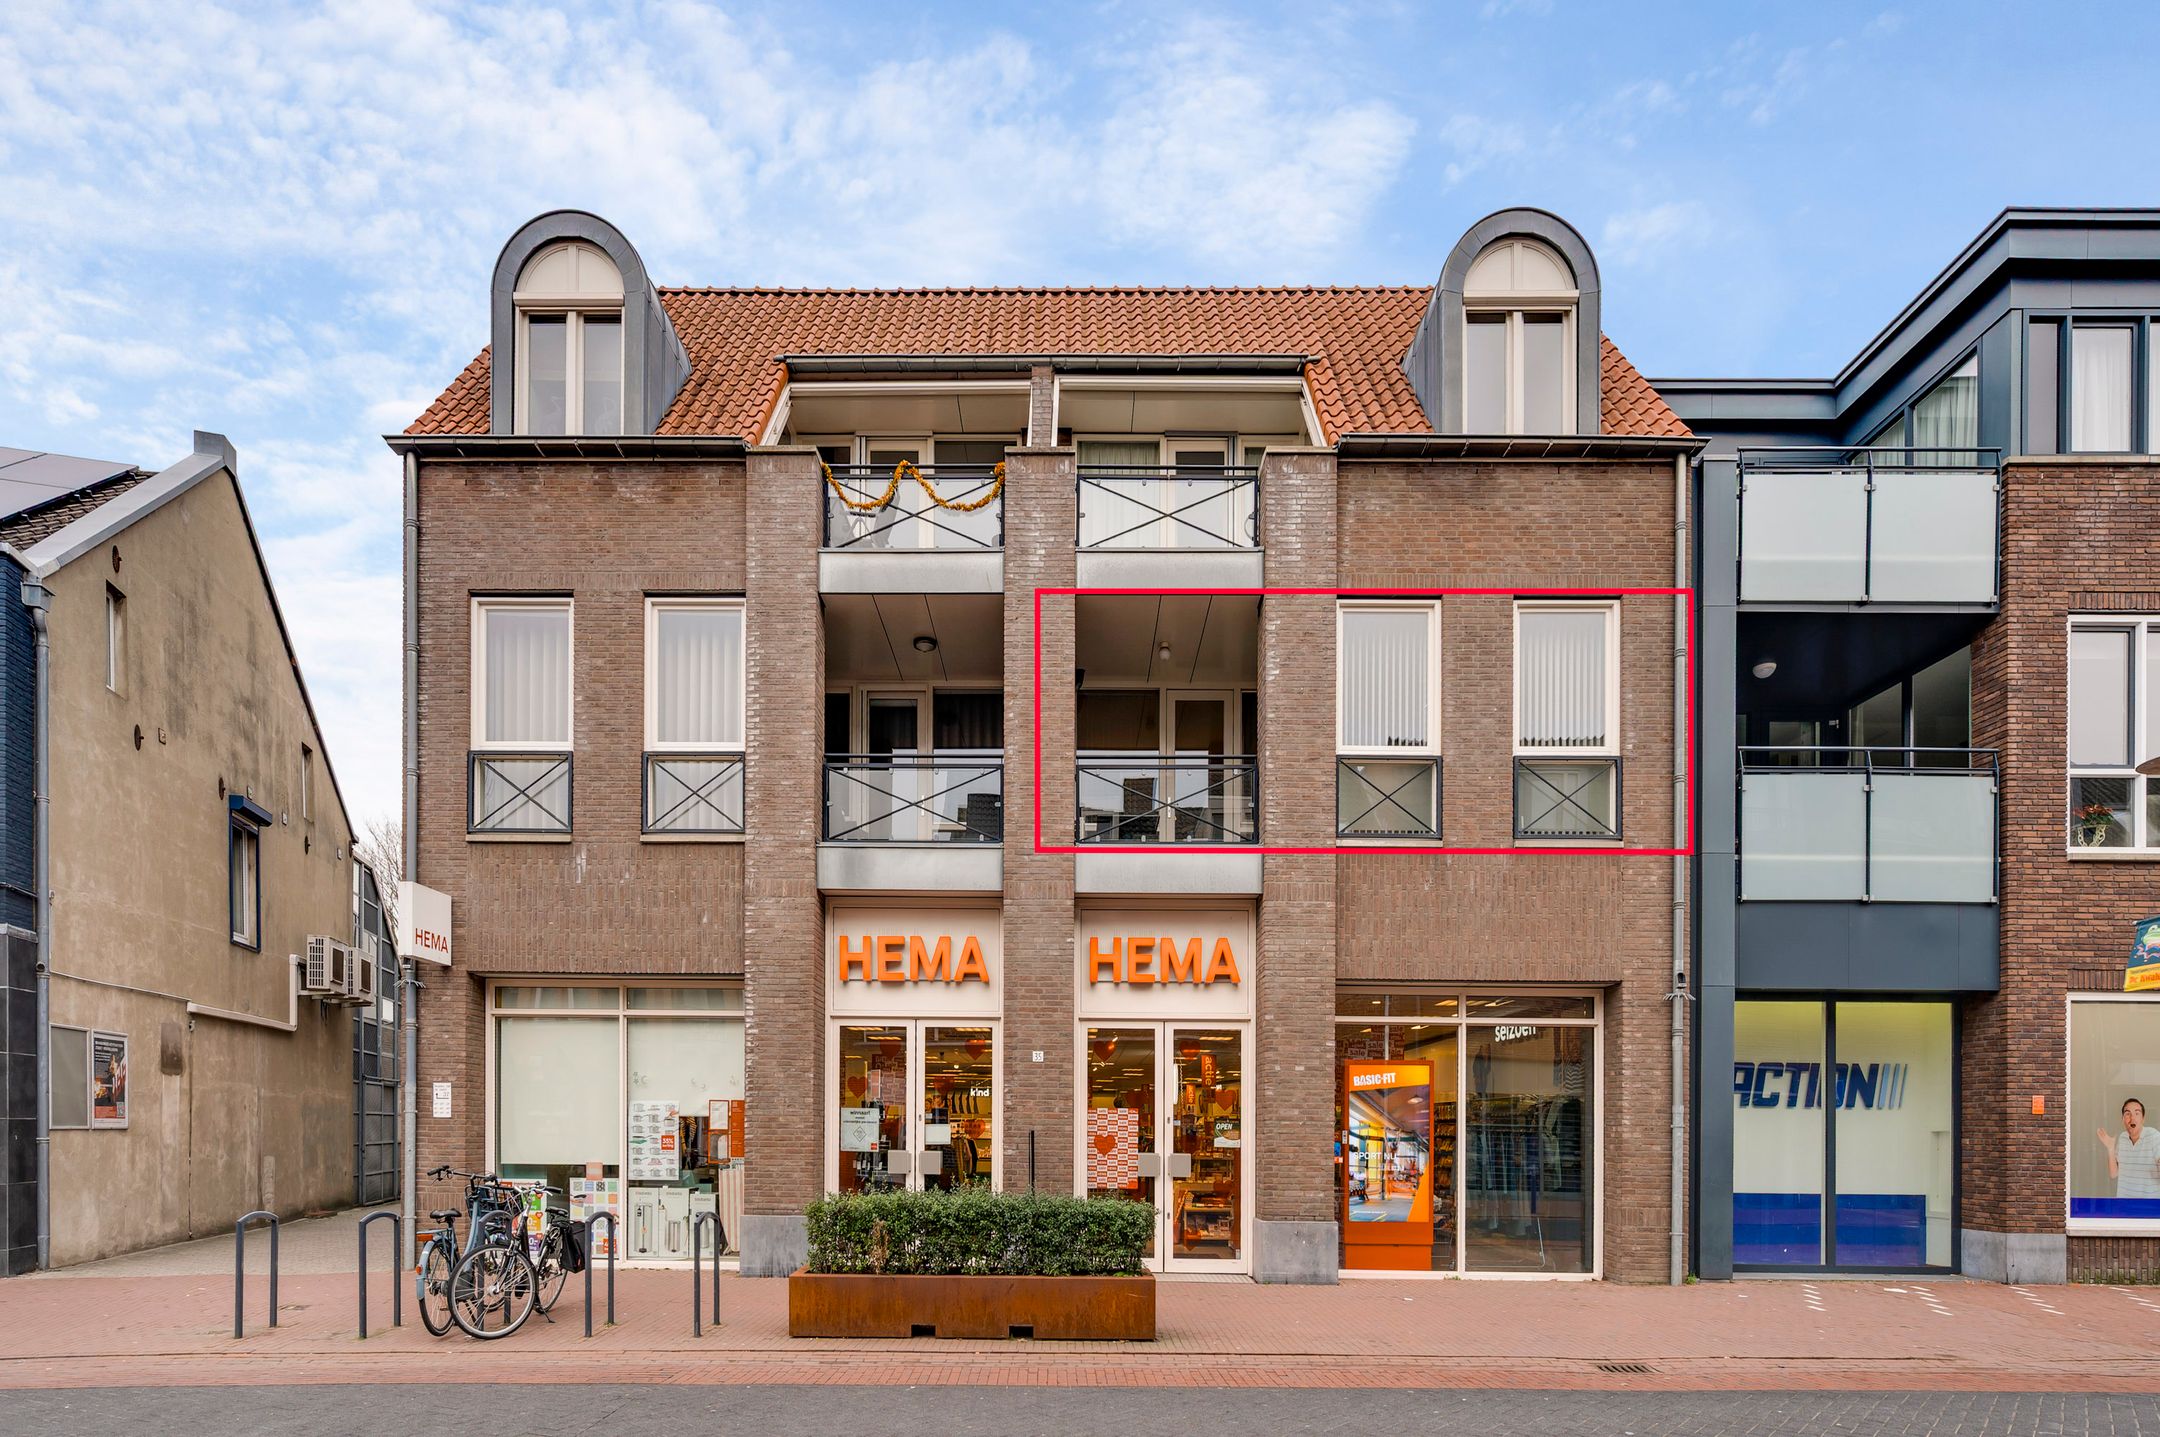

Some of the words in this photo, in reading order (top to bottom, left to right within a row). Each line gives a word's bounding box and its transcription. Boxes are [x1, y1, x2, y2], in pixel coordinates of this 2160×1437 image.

[415, 928, 448, 953] HEMA
[840, 936, 989, 982] HEMA
[1090, 937, 1241, 983] HEMA
[1205, 1056, 1214, 1086] actie
[1353, 1072, 1396, 1086] BASIC-FIT
[1734, 1062, 1879, 1108] ACTION
[970, 1088, 989, 1096] kind
